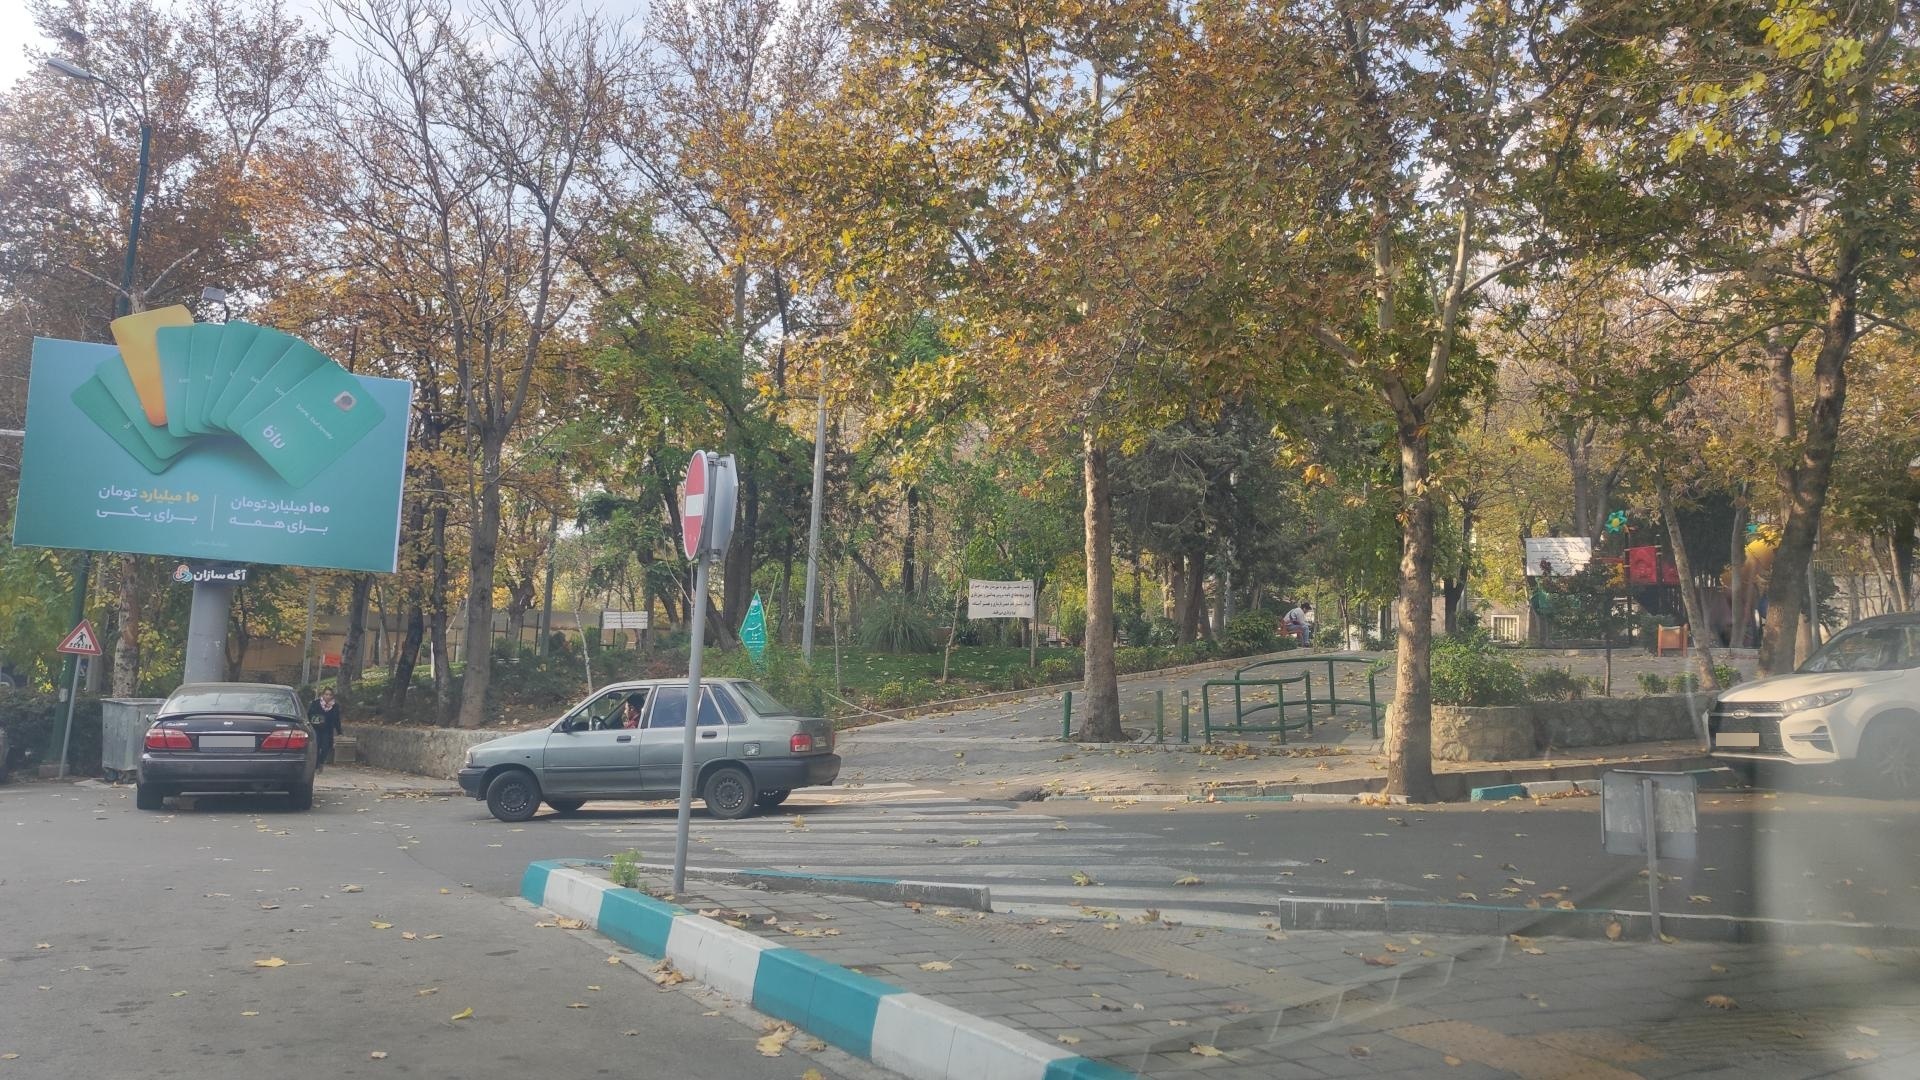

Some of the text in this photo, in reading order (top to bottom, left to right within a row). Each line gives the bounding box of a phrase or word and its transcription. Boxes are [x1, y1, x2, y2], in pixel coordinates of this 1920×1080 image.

[98, 484, 138, 501] تومان
[139, 487, 182, 504] میلیارد
[231, 496, 267, 511] تومان
[267, 499, 308, 515] میلیارد
[96, 505, 198, 525] برای یکی
[229, 516, 329, 535] برای همه
[193, 569, 247, 582] آگه سازان
